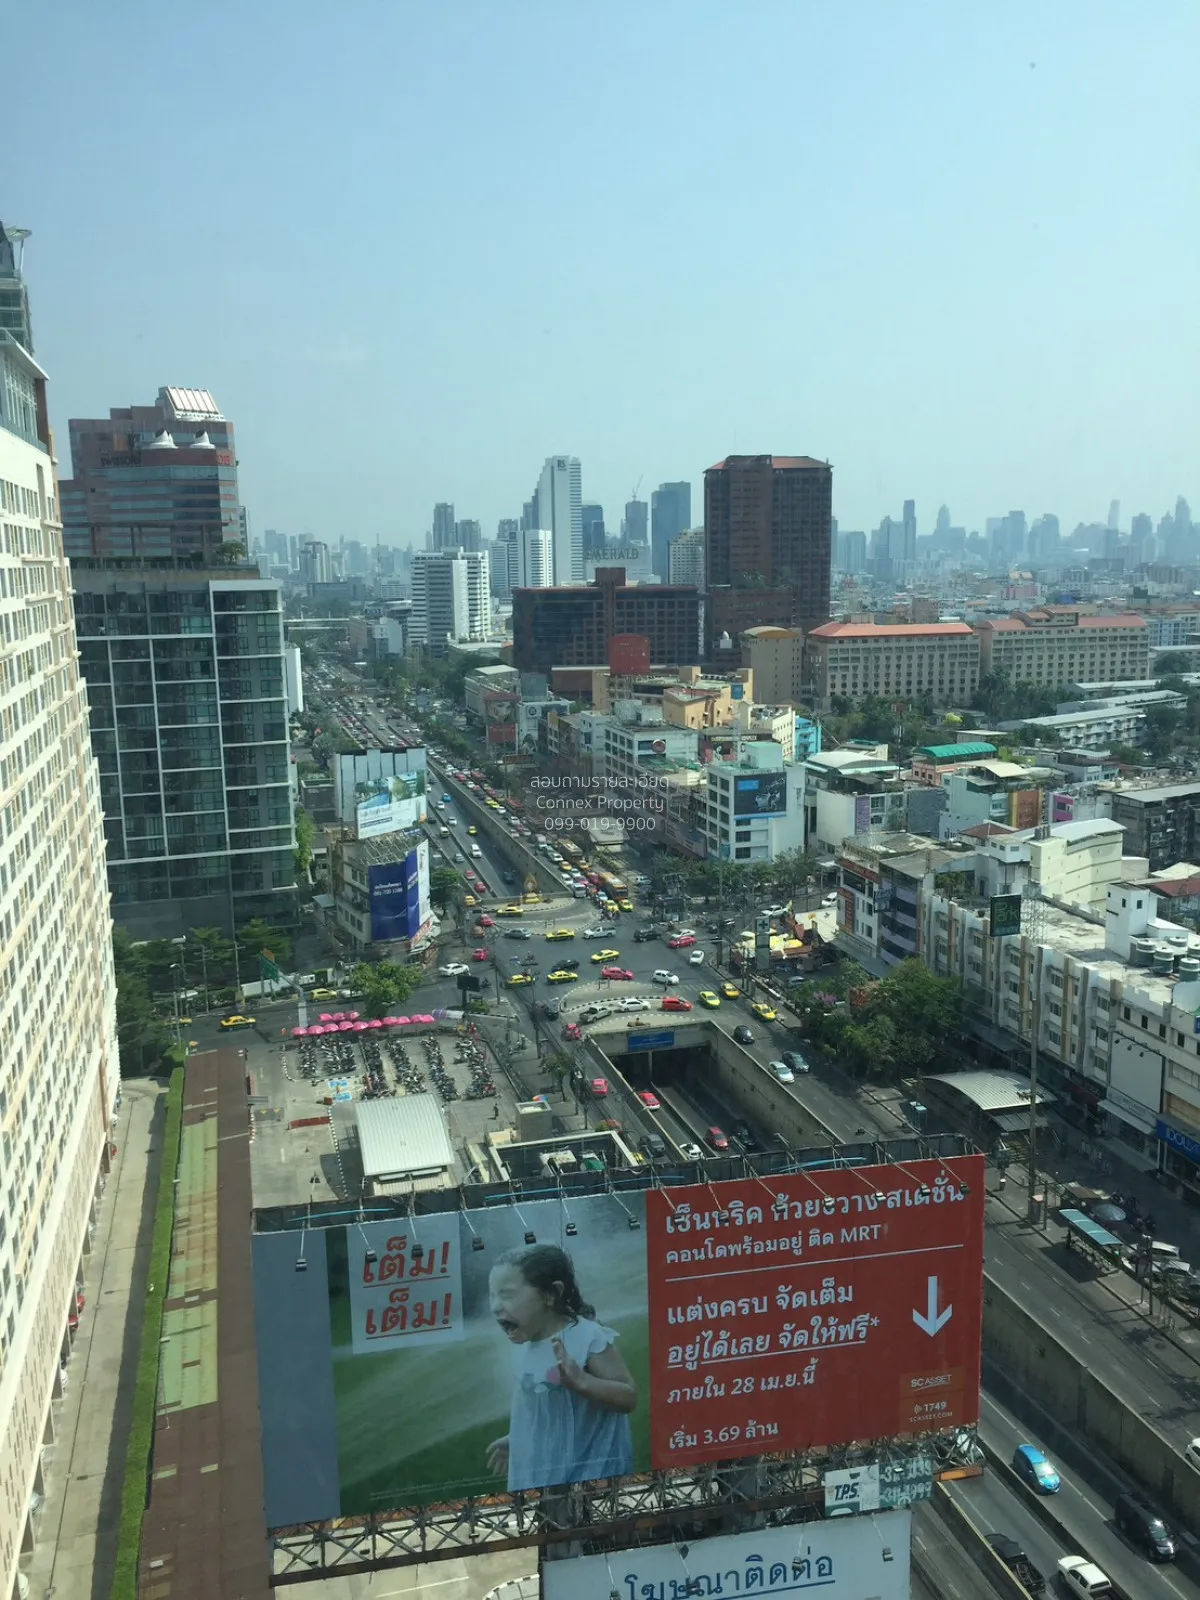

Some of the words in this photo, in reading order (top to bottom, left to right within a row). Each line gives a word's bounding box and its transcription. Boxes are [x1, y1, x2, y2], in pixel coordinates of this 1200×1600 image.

[666, 1230, 803, 1264] คอนโดพร้อมอยู่
[808, 1228, 835, 1247] ติด
[840, 1224, 882, 1244] MRT
[366, 1287, 452, 1335] เต็ม!
[667, 1296, 769, 1325] แต่งครบ
[775, 1276, 854, 1310] จัดเต็ม
[668, 1330, 771, 1371] อยู่ได้เลย
[667, 1375, 726, 1404] ภายใน
[730, 1376, 756, 1395] 28
[910, 1378, 924, 1388] SC
[924, 1401, 947, 1412] 1749
[668, 1425, 698, 1450] เริ่ม
[703, 1425, 740, 1445] 3.69
[745, 1419, 779, 1439] ล้าน
